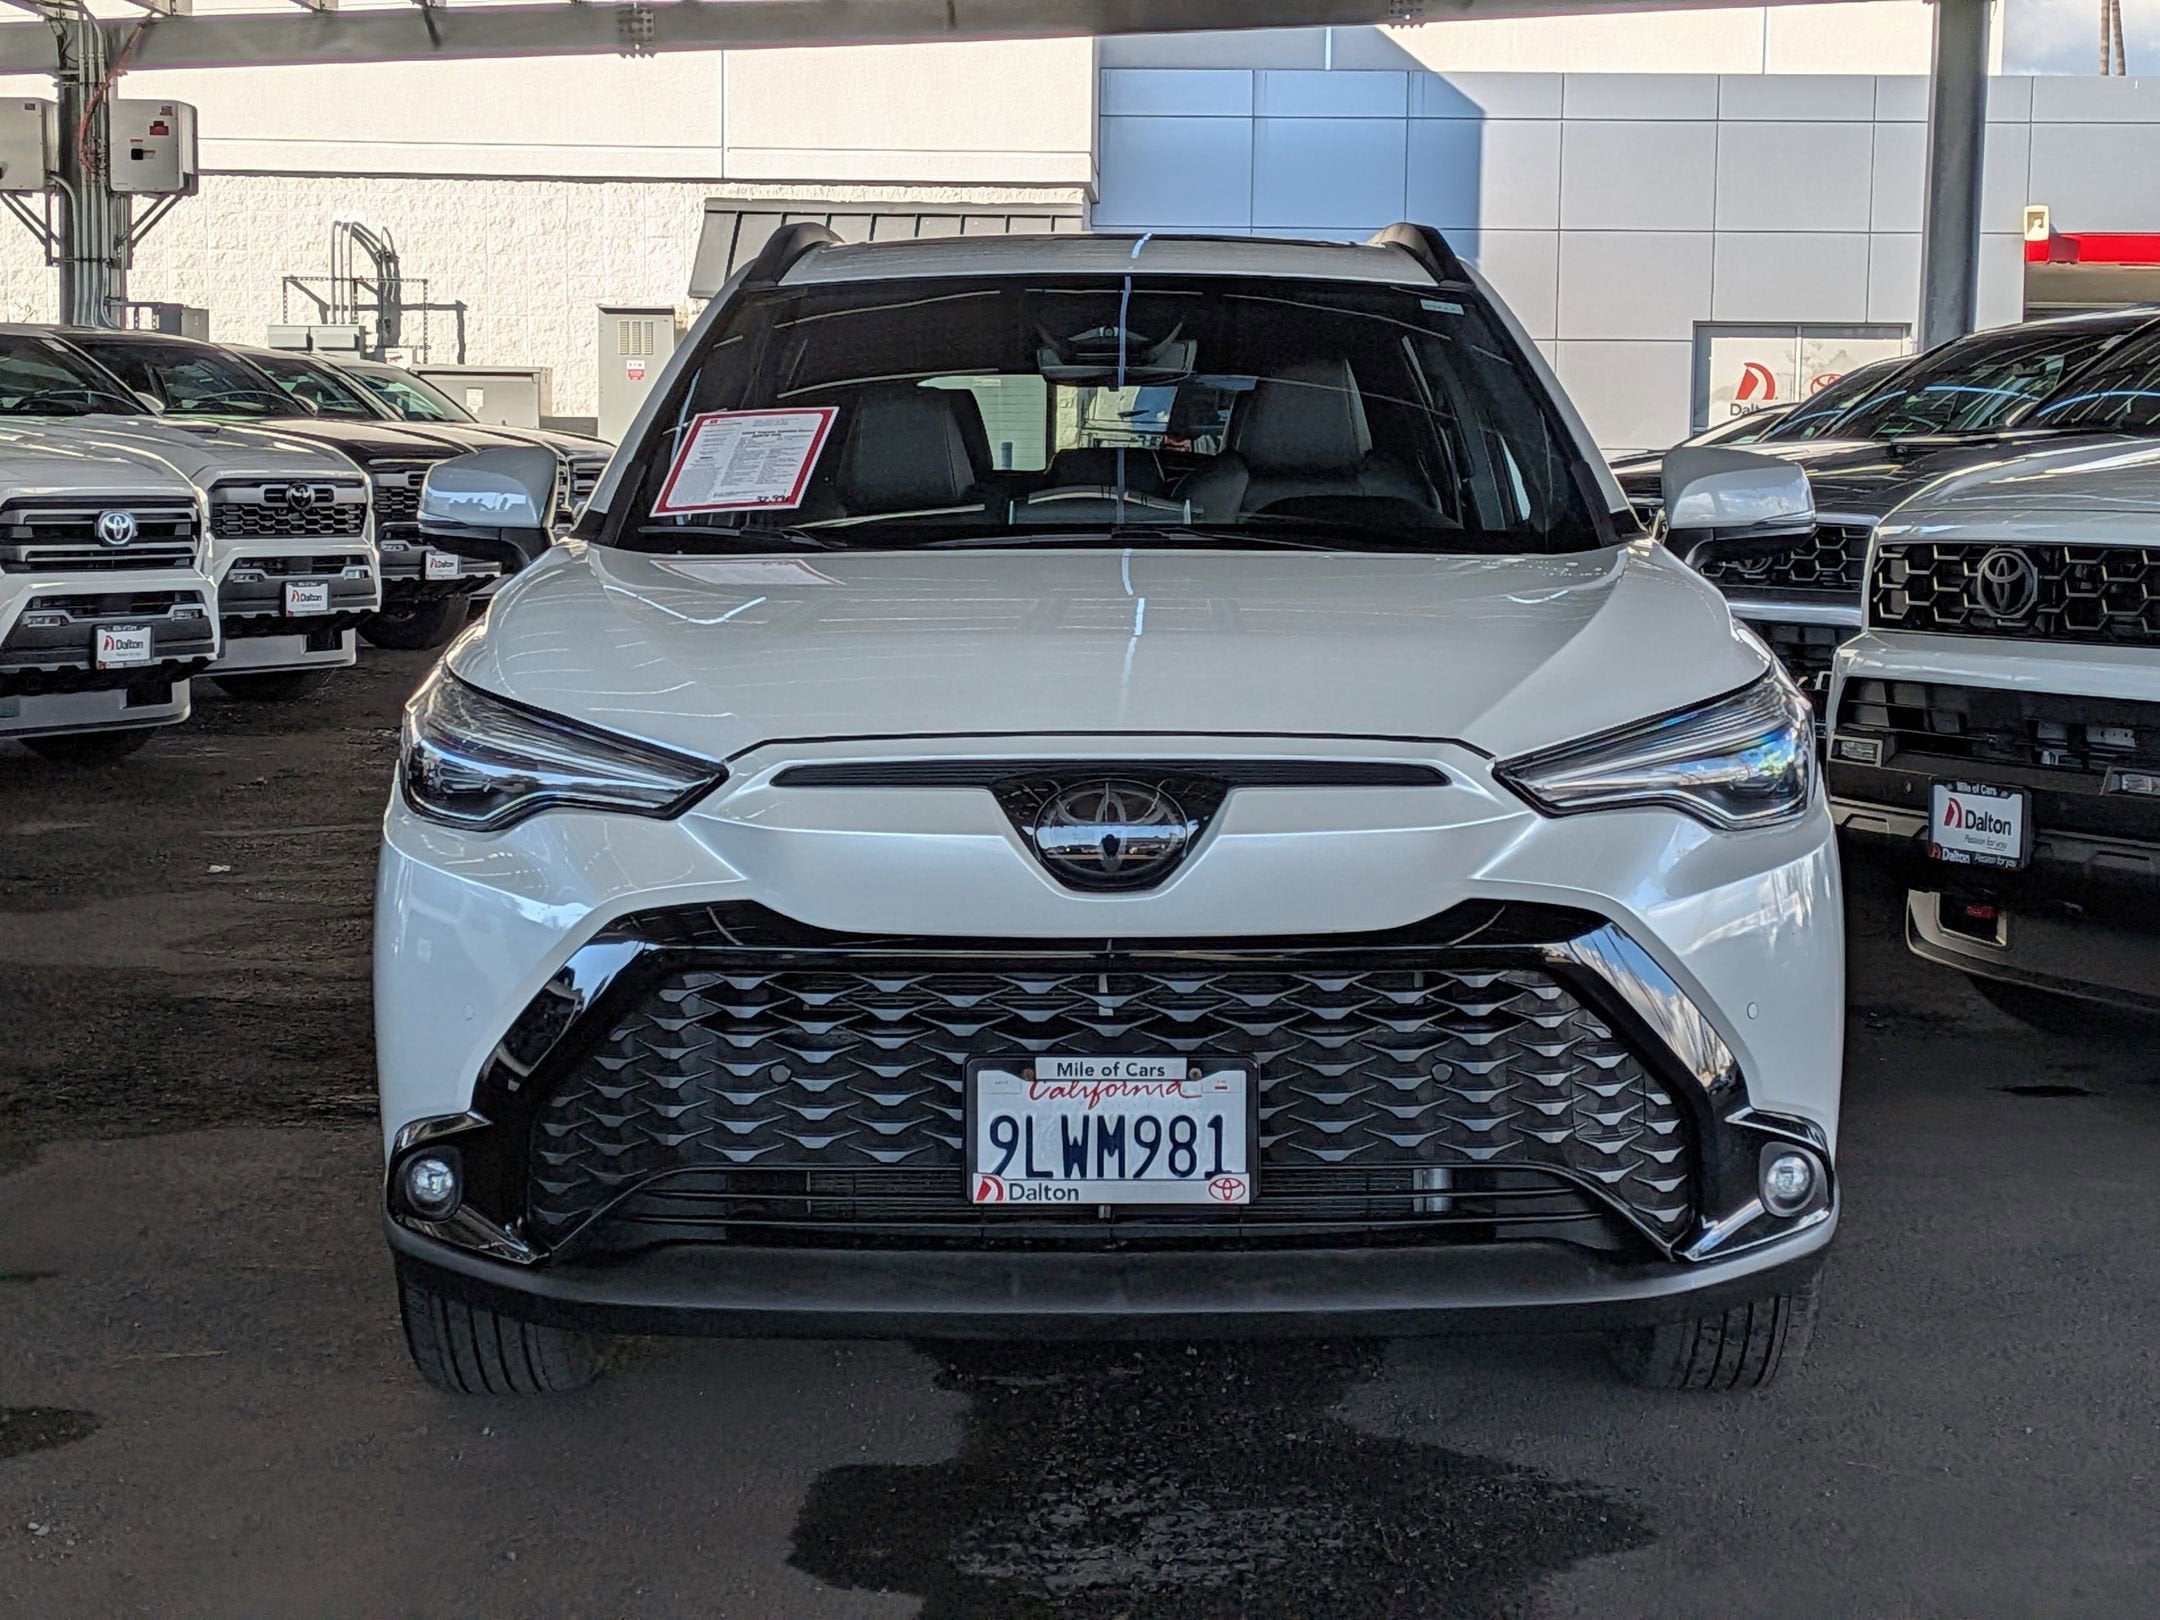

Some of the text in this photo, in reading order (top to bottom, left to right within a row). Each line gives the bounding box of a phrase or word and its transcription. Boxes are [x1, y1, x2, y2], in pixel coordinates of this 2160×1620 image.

[301, 593, 322, 602] Dalton
[116, 639, 144, 650] Dalton
[1965, 809, 2011, 836] Dalton
[1057, 1062, 1166, 1077] Mile of Cars
[1028, 1080, 1202, 1110] California
[990, 1114, 1232, 1179] 9LWM981
[1008, 1183, 1080, 1201] Dalton
